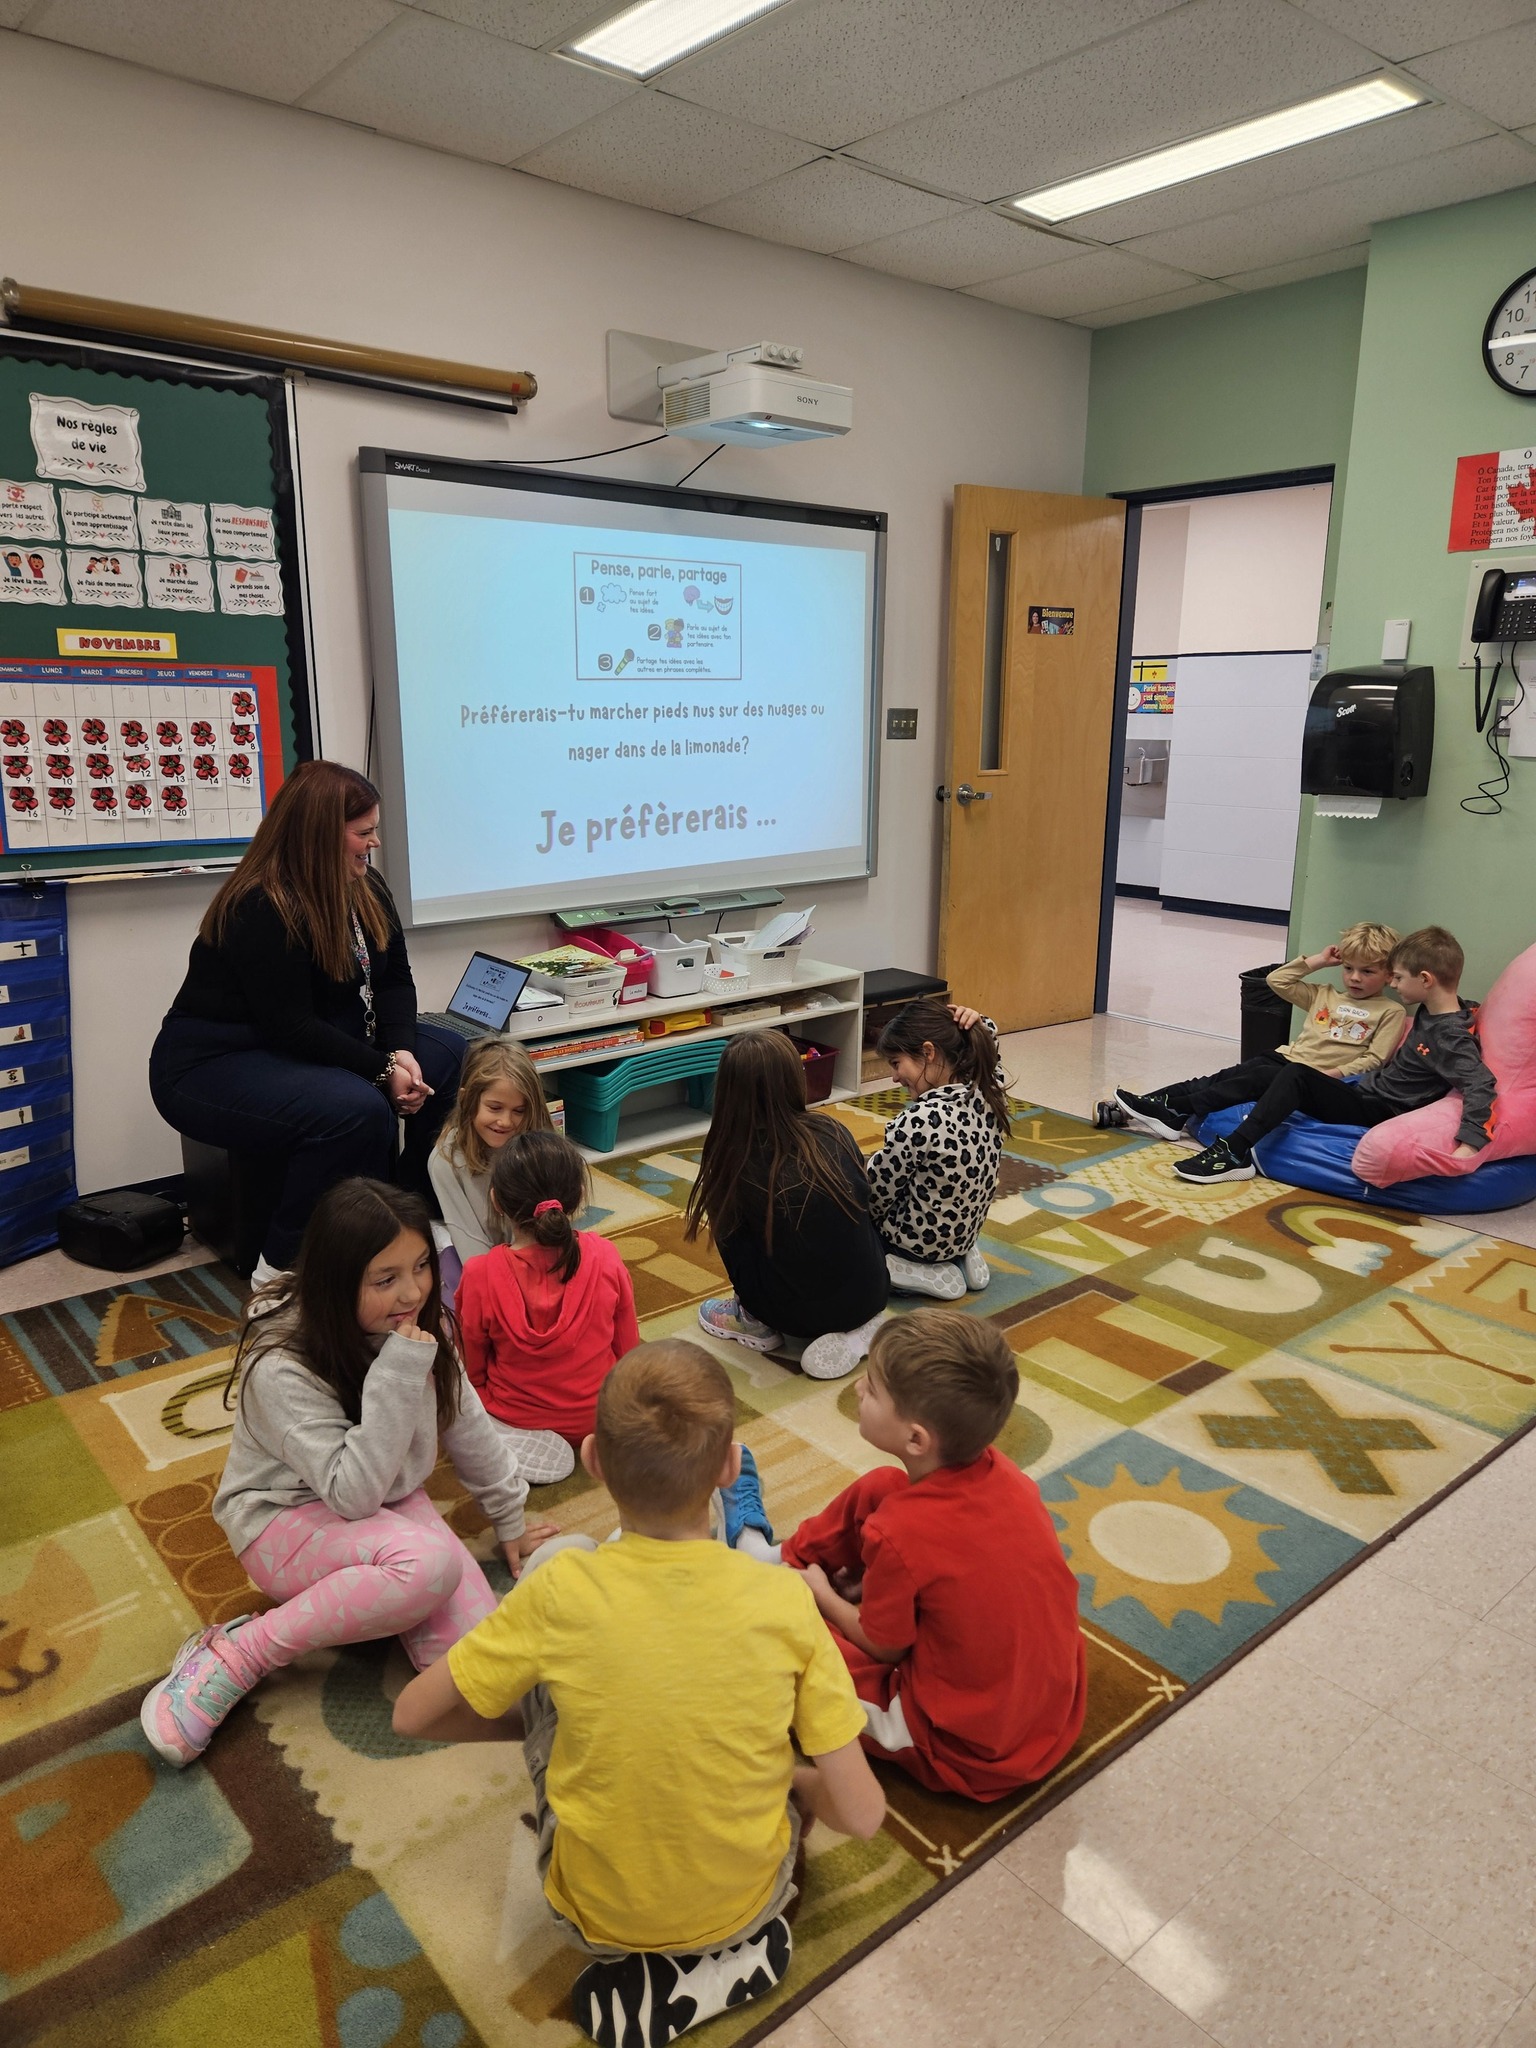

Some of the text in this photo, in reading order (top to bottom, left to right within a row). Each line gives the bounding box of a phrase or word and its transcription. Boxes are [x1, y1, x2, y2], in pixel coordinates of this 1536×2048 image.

[1507, 308, 1524, 323] 10
[1505, 352, 1514, 366] 8
[1521, 365, 1529, 379] 7
[796, 395, 819, 406] SONY
[57, 416, 117, 436] Nos règles
[72, 438, 107, 453] de vie
[394, 461, 415, 471] SMART
[1487, 465, 1515, 474] Canada,
[73, 511, 100, 519] participe
[89, 522, 128, 532] apprentissage
[231, 516, 268, 529] RESPONSABLE
[592, 560, 727, 585] Pense, parle, partage
[583, 588, 593, 603] 1
[629, 588, 657, 597] Pense fort
[639, 599, 650, 607] sujet
[1041, 608, 1074, 619] Bienvenue
[649, 625, 660, 639] 2
[687, 623, 699, 631] Parle
[708, 624, 720, 632] sujet
[79, 636, 161, 652] NOVEMBRE
[600, 656, 611, 669] 3
[637, 657, 655, 665] Partage
[115, 668, 143, 676] MERCREDI
[157, 670, 175, 678] JEUDI
[664, 666, 684, 674] phrases
[461, 701, 825, 728] Préférerais-tu marcher pieds nus sur des nuages ou
[1336, 703, 1357, 718] Scott
[251, 714, 255, 722] 1
[23, 746, 29, 754] 2
[101, 744, 107, 752] 4
[144, 743, 149, 751] 5
[250, 743, 256, 751] 8
[568, 735, 749, 763] nager dans de la limonade?
[141, 770, 151, 778] 12
[175, 775, 185, 783] 13
[25, 776, 31, 784] 9
[62, 777, 73, 785] 10
[104, 776, 113, 784] 11
[209, 777, 219, 785] 14
[241, 776, 251, 785] 15
[27, 809, 38, 818] 16
[63, 808, 73, 816] 17
[107, 808, 117, 817] 18
[142, 807, 152, 816] 19
[176, 808, 187, 817] 20
[536, 810, 575, 854] Je
[587, 800, 748, 853] préfèrerais
[1142, 1236, 1323, 1314] U
[95, 1293, 243, 1367] A
[1002, 1289, 1206, 1385] T
[1329, 1300, 1536, 1385] Y
[1199, 1377, 1438, 1496] X
